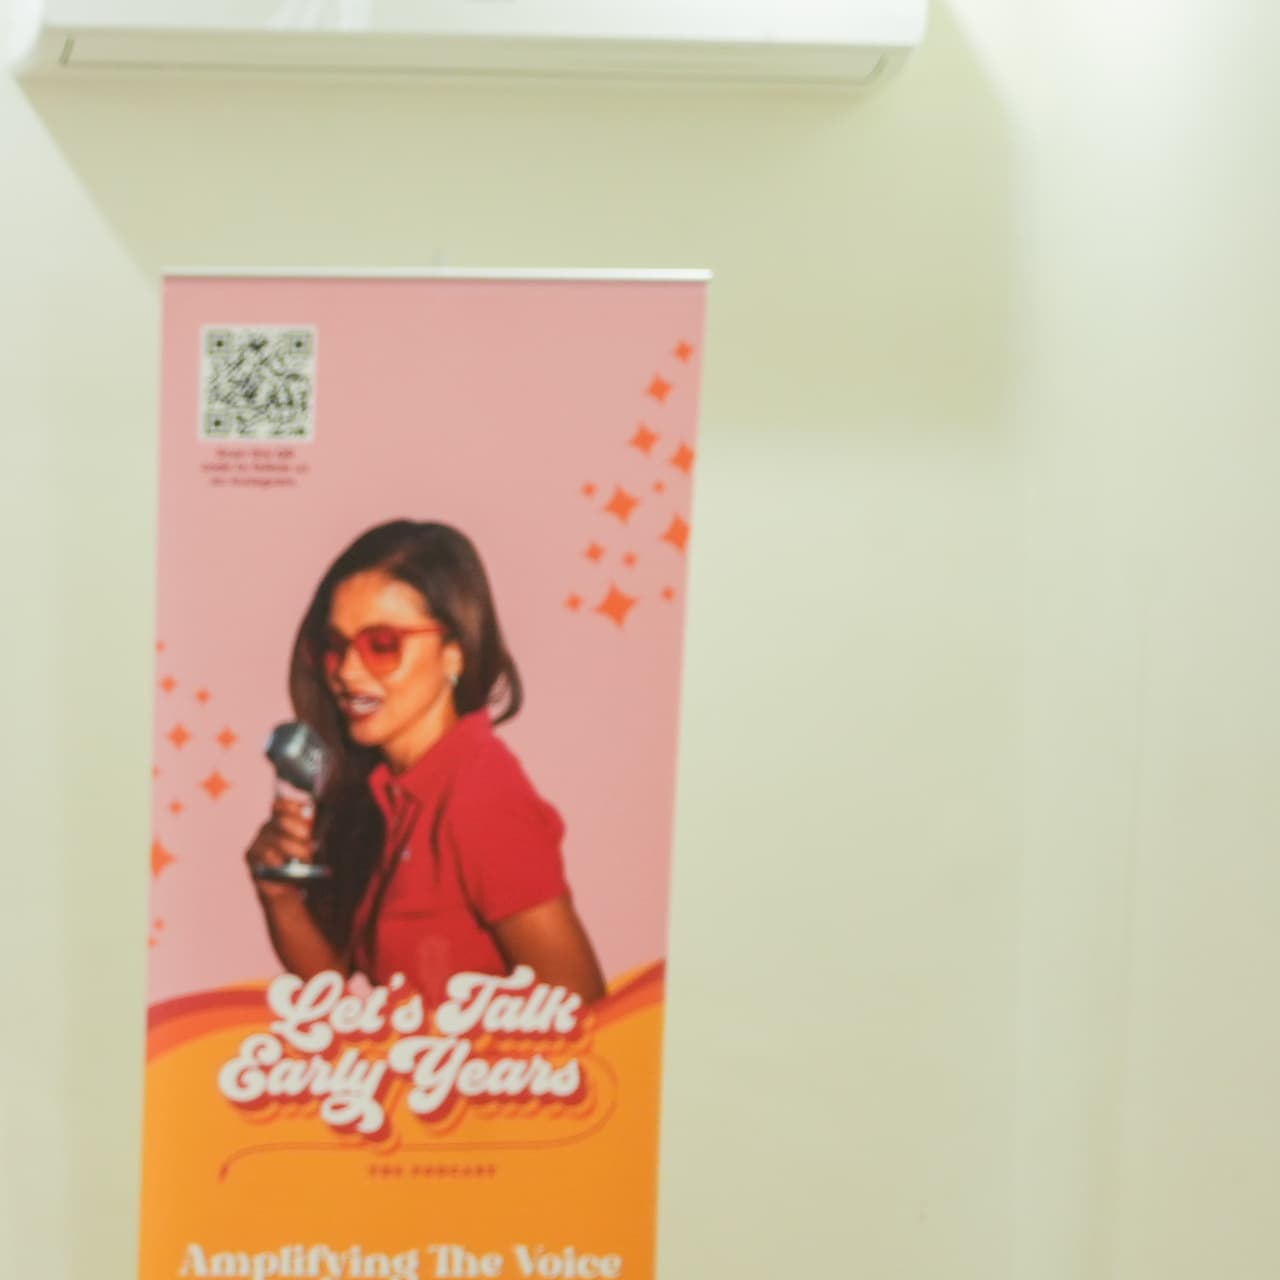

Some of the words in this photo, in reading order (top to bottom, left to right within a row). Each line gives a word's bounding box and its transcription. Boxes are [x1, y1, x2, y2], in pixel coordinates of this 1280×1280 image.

[267, 970, 424, 1052] Let's
[434, 965, 582, 1035] Talk
[218, 1033, 388, 1133] Early
[387, 1036, 581, 1114] Years
[427, 1244, 503, 1277] The
[514, 1244, 622, 1279] Voice
